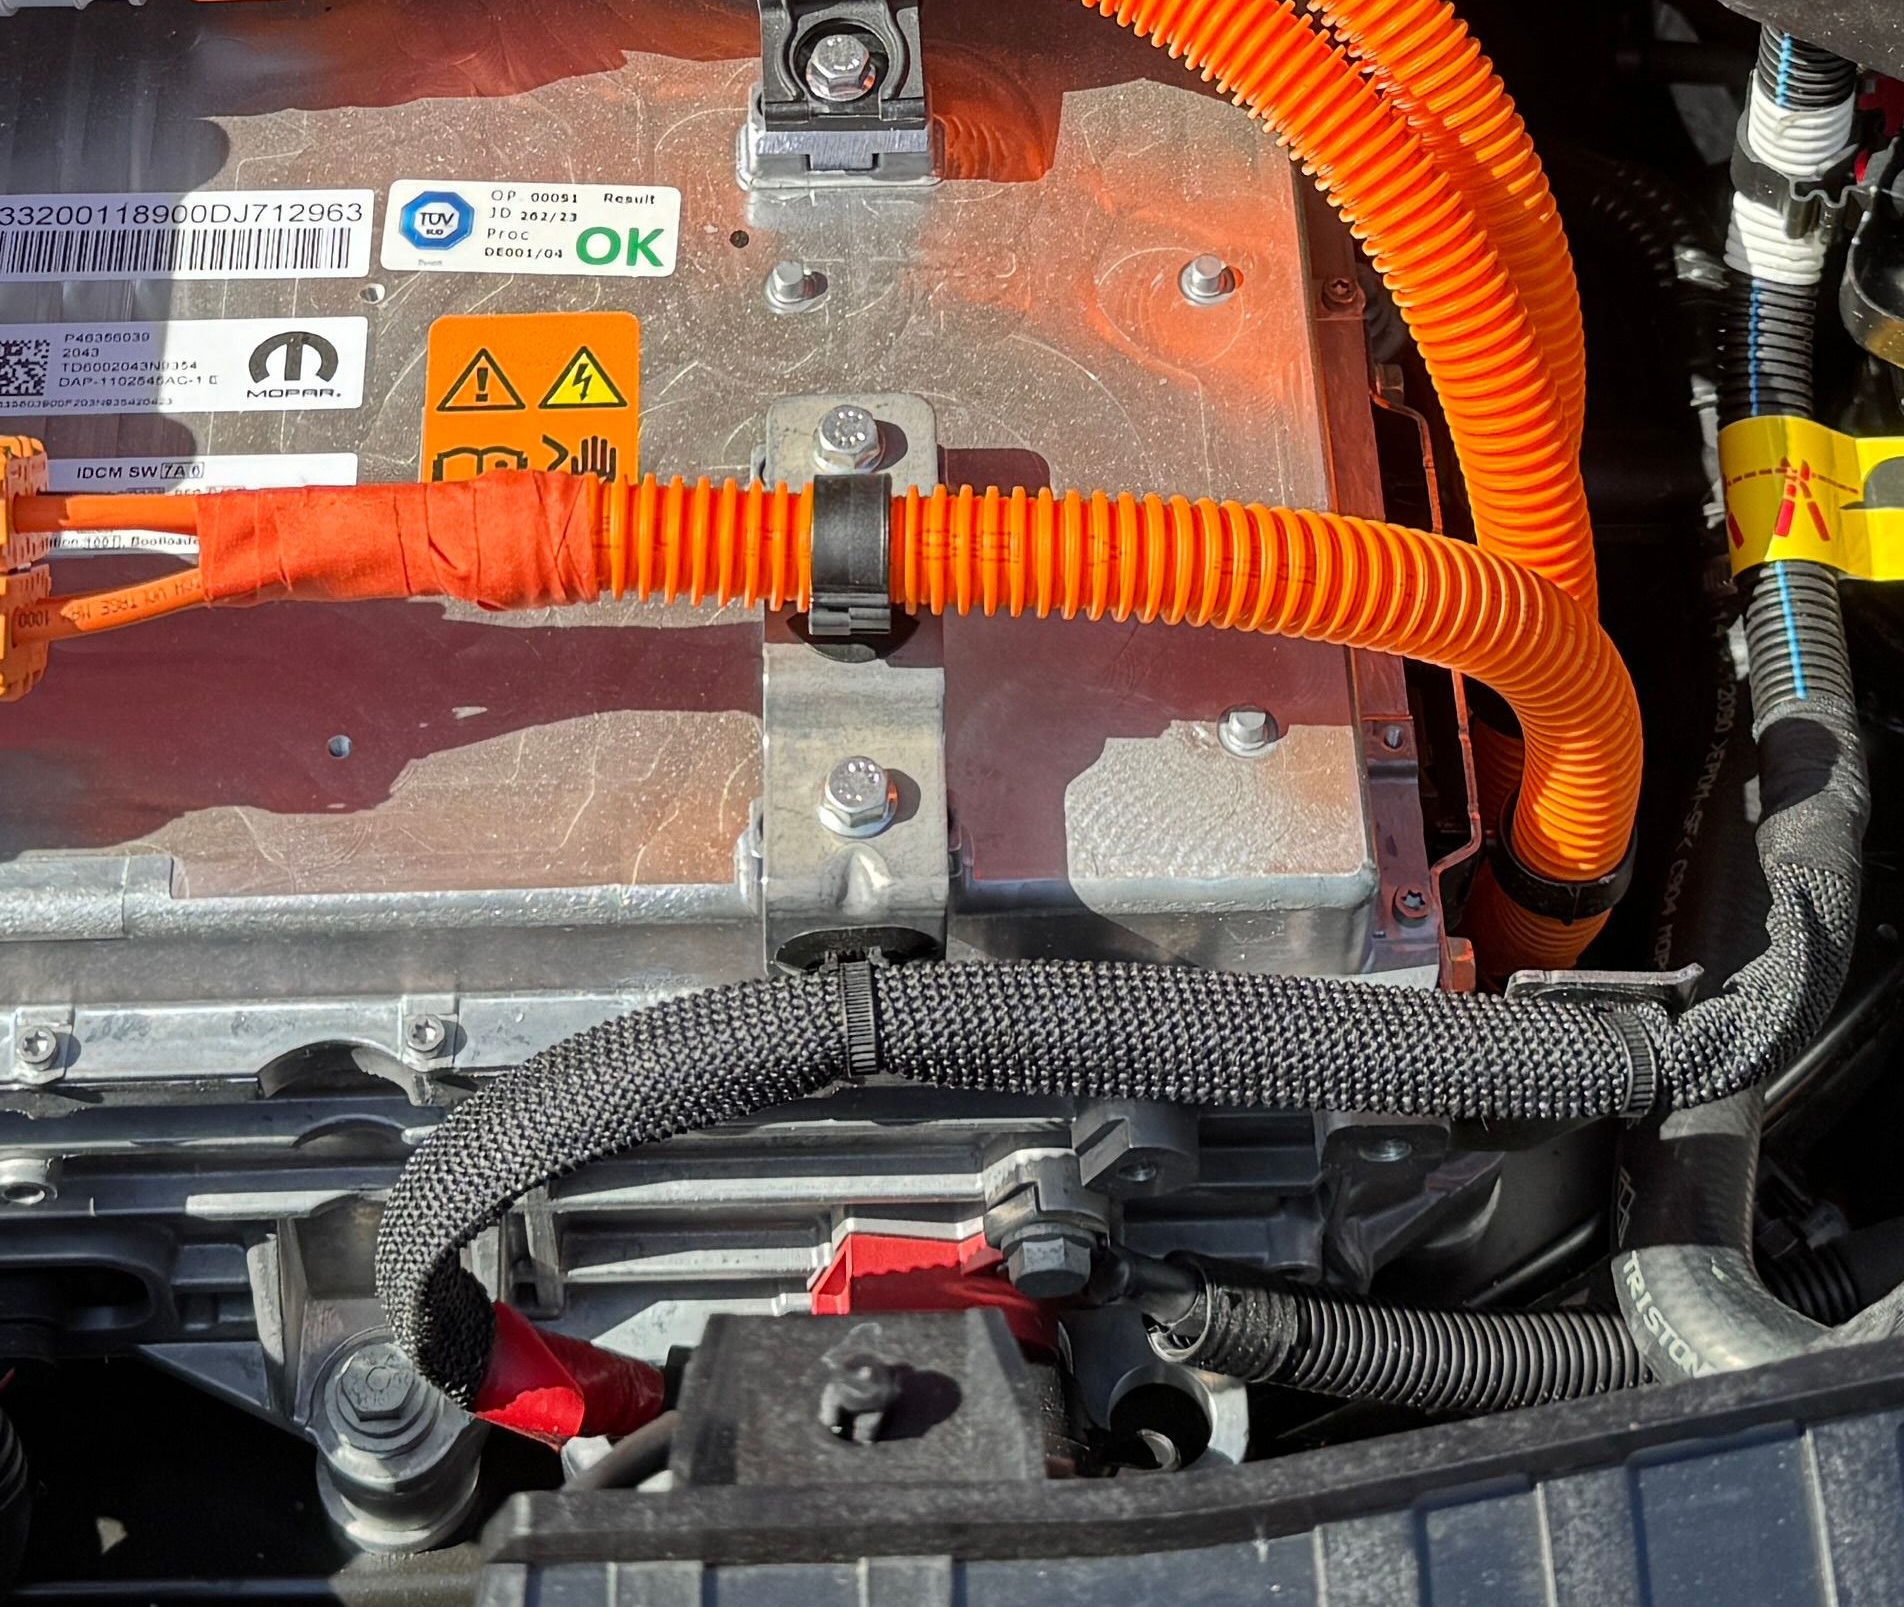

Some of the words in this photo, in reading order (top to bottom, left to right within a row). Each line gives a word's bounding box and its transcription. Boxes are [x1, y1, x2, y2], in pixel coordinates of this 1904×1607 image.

[603, 193, 656, 205] Result
[487, 227, 529, 241] Proc
[576, 226, 664, 267] OK
[77, 466, 122, 479] IDCM
[129, 466, 158, 478] SW
